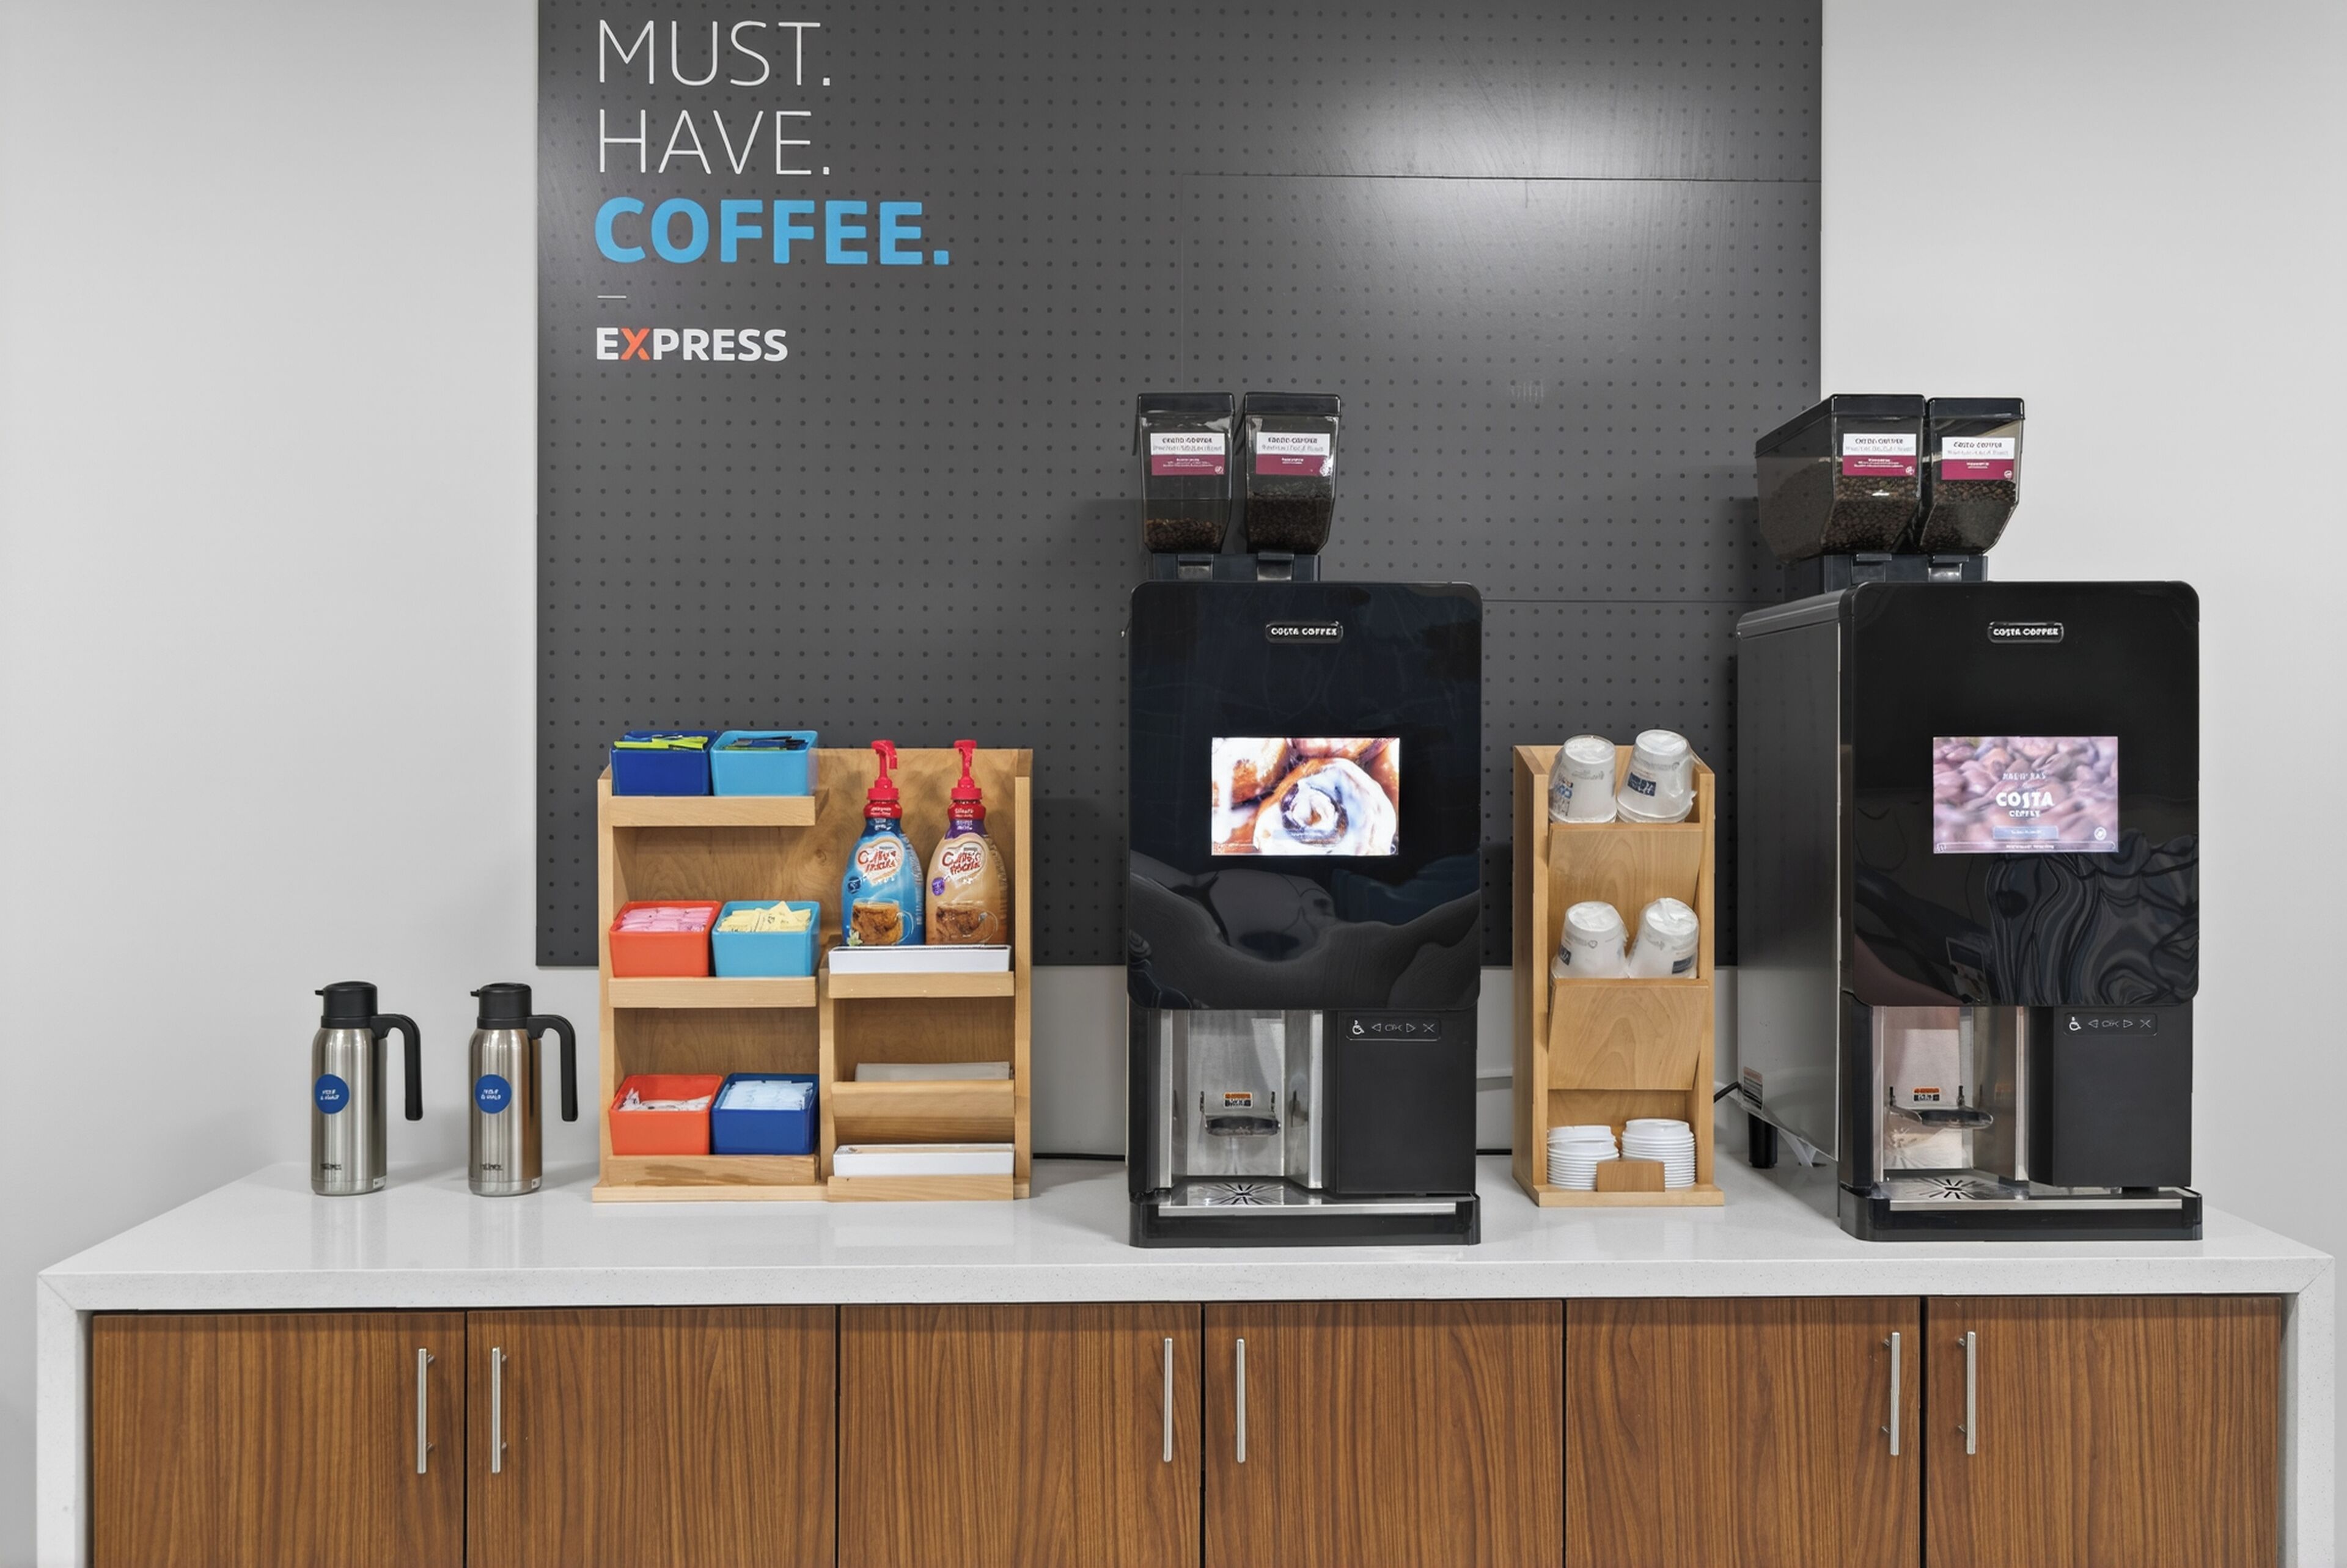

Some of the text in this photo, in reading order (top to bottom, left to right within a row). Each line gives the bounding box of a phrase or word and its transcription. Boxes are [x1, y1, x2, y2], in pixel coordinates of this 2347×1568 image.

[600, 20, 830, 86] MUST.
[600, 109, 829, 175] HAVE.
[595, 197, 949, 265] COFFEE.
[596, 327, 788, 362] EXPRESS
[1993, 628, 2021, 637] COSTA
[1996, 792, 2055, 808] COSTA
